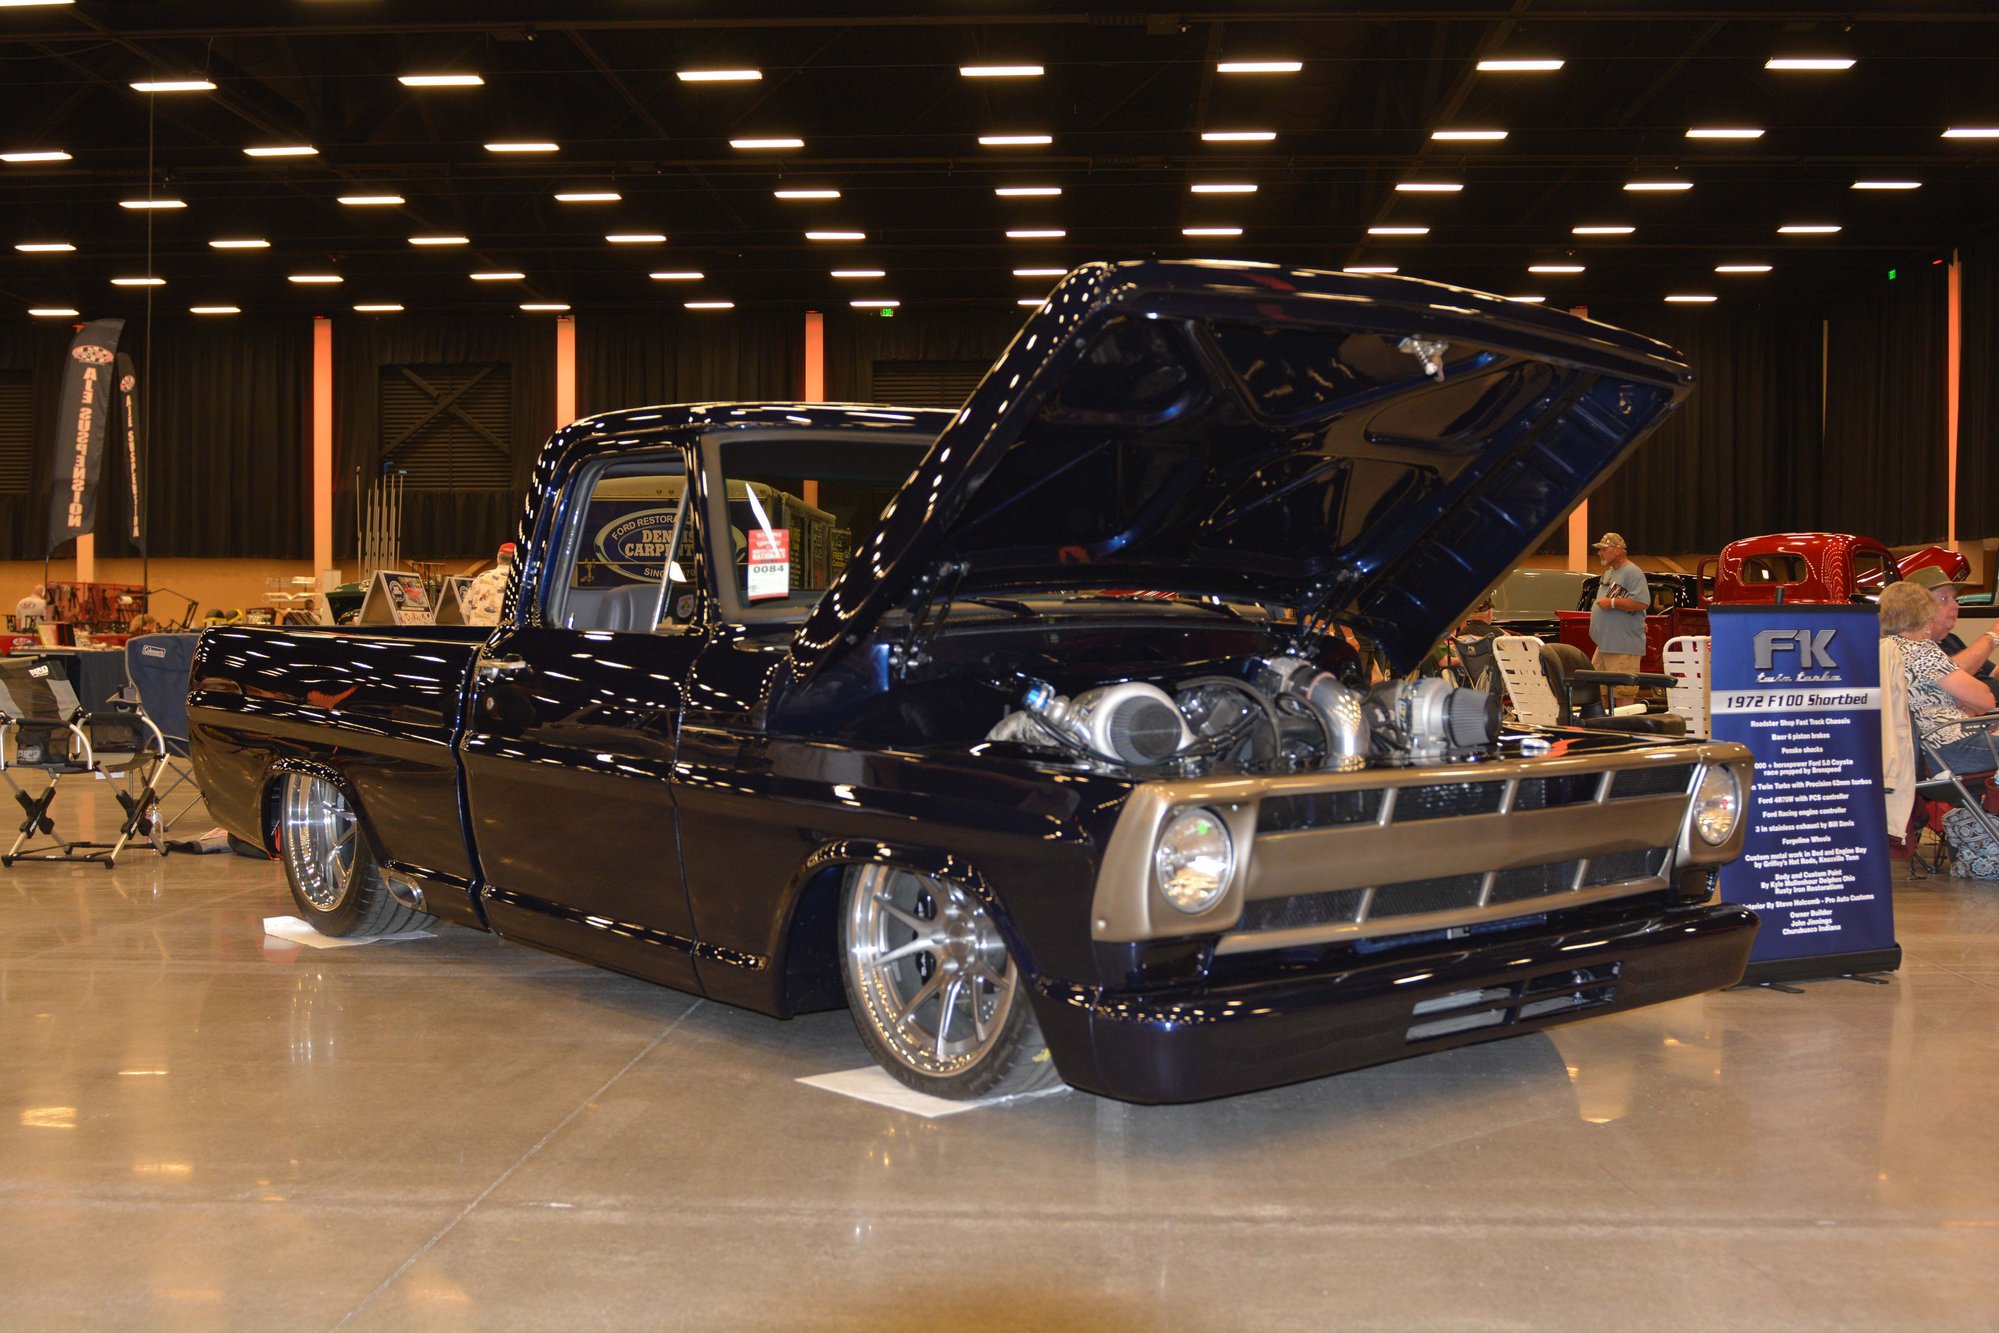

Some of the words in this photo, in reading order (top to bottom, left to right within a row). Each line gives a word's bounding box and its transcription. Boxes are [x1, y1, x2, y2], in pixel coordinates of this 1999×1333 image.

[611, 522, 635, 540] FORD
[753, 565, 784, 573] 0084
[1727, 696, 1764, 708] 1972
[1768, 695, 1803, 707] F100
[1808, 693, 1868, 706] Shortbed
[1769, 824, 1795, 832] stainless
[1796, 822, 1819, 830] exhaust
[1806, 884, 1844, 892] Restorations
[1775, 900, 1793, 908] Steve
[1794, 898, 1820, 906] Holcomb
